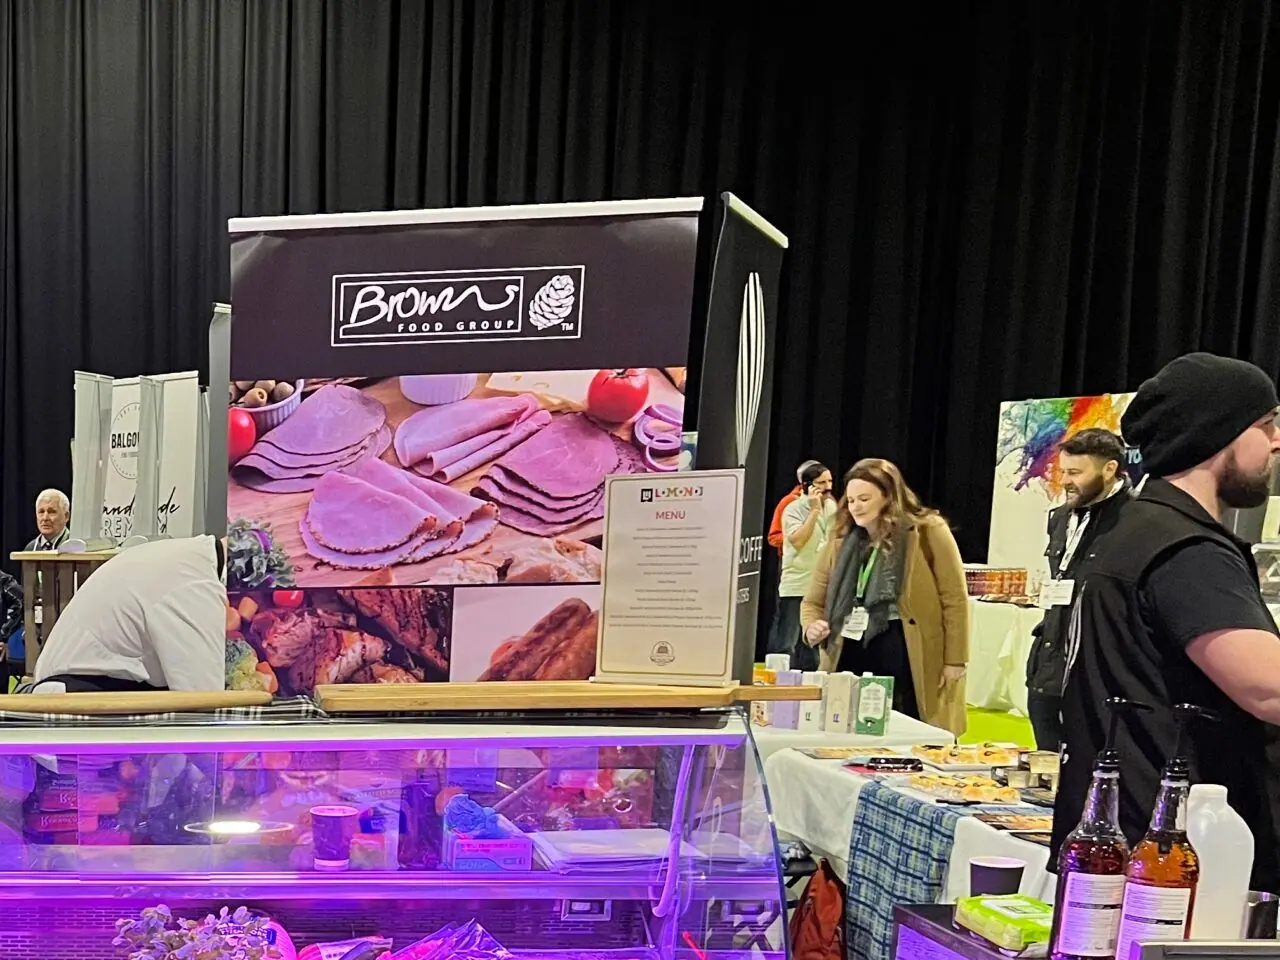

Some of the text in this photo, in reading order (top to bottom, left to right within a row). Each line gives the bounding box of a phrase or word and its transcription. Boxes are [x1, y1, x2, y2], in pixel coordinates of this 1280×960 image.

[398, 320, 514, 332] FOOD GROUP
[111, 432, 140, 449] BALGO
[655, 510, 686, 519] MENU
